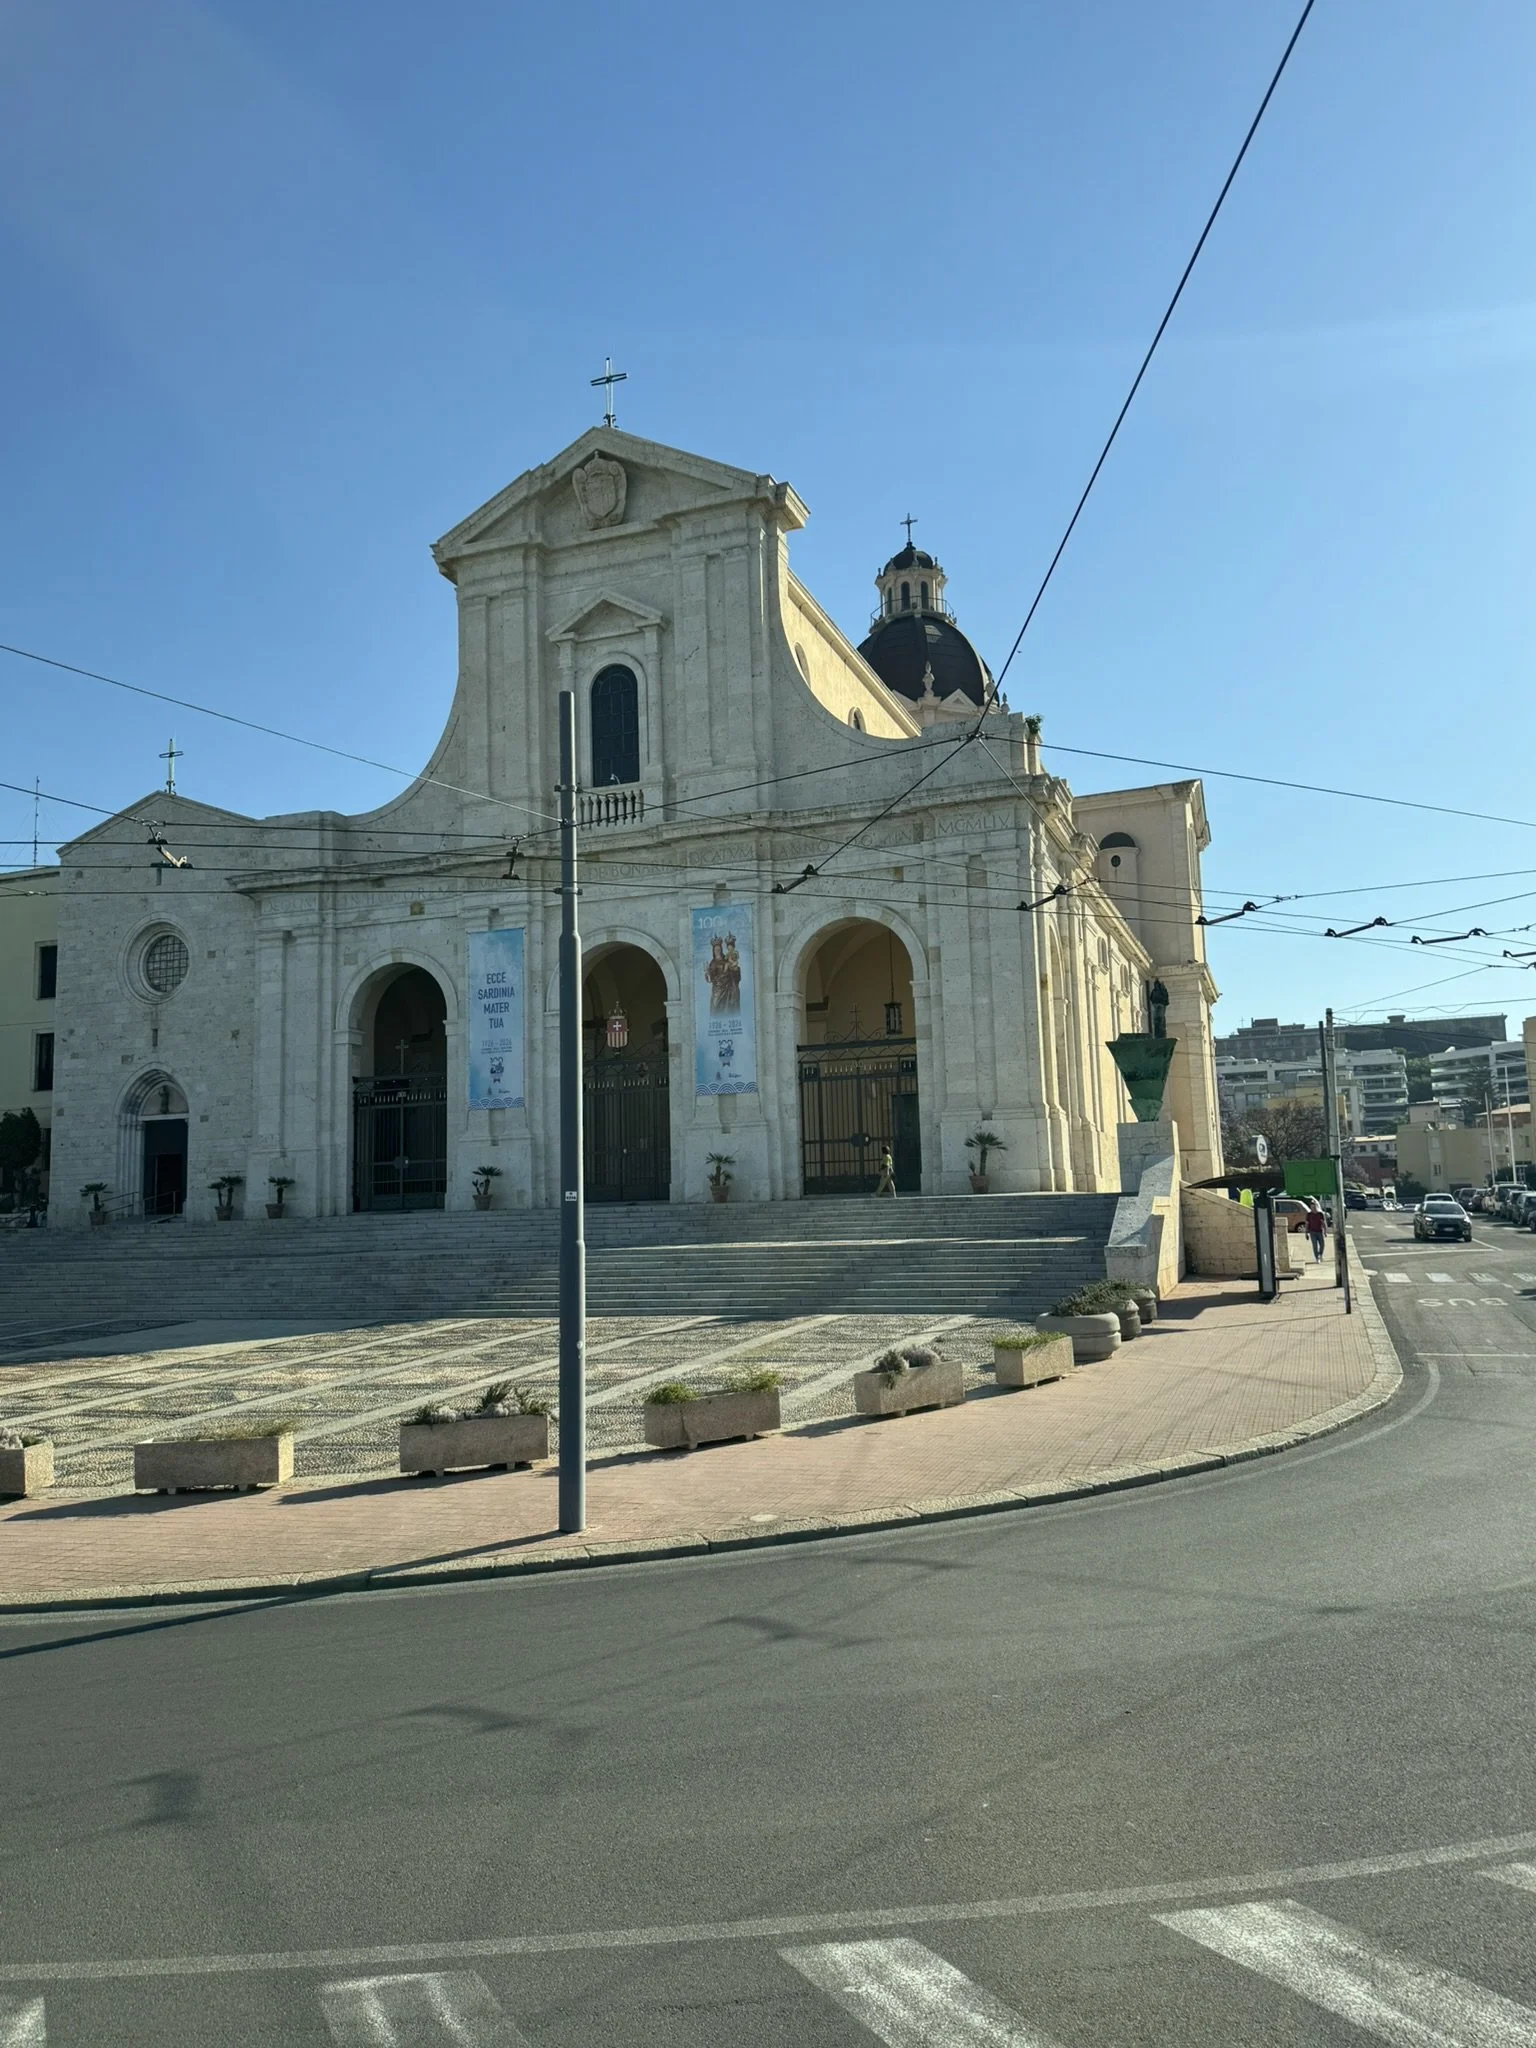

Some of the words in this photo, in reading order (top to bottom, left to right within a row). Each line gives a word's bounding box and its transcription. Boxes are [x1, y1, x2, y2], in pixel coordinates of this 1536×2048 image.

[938, 813, 1011, 835] MCMLIV
[486, 972, 506, 985] ECCE
[478, 986, 515, 1000] SARDINIA
[483, 1001, 510, 1015] MATER
[488, 1017, 504, 1030] TUA
